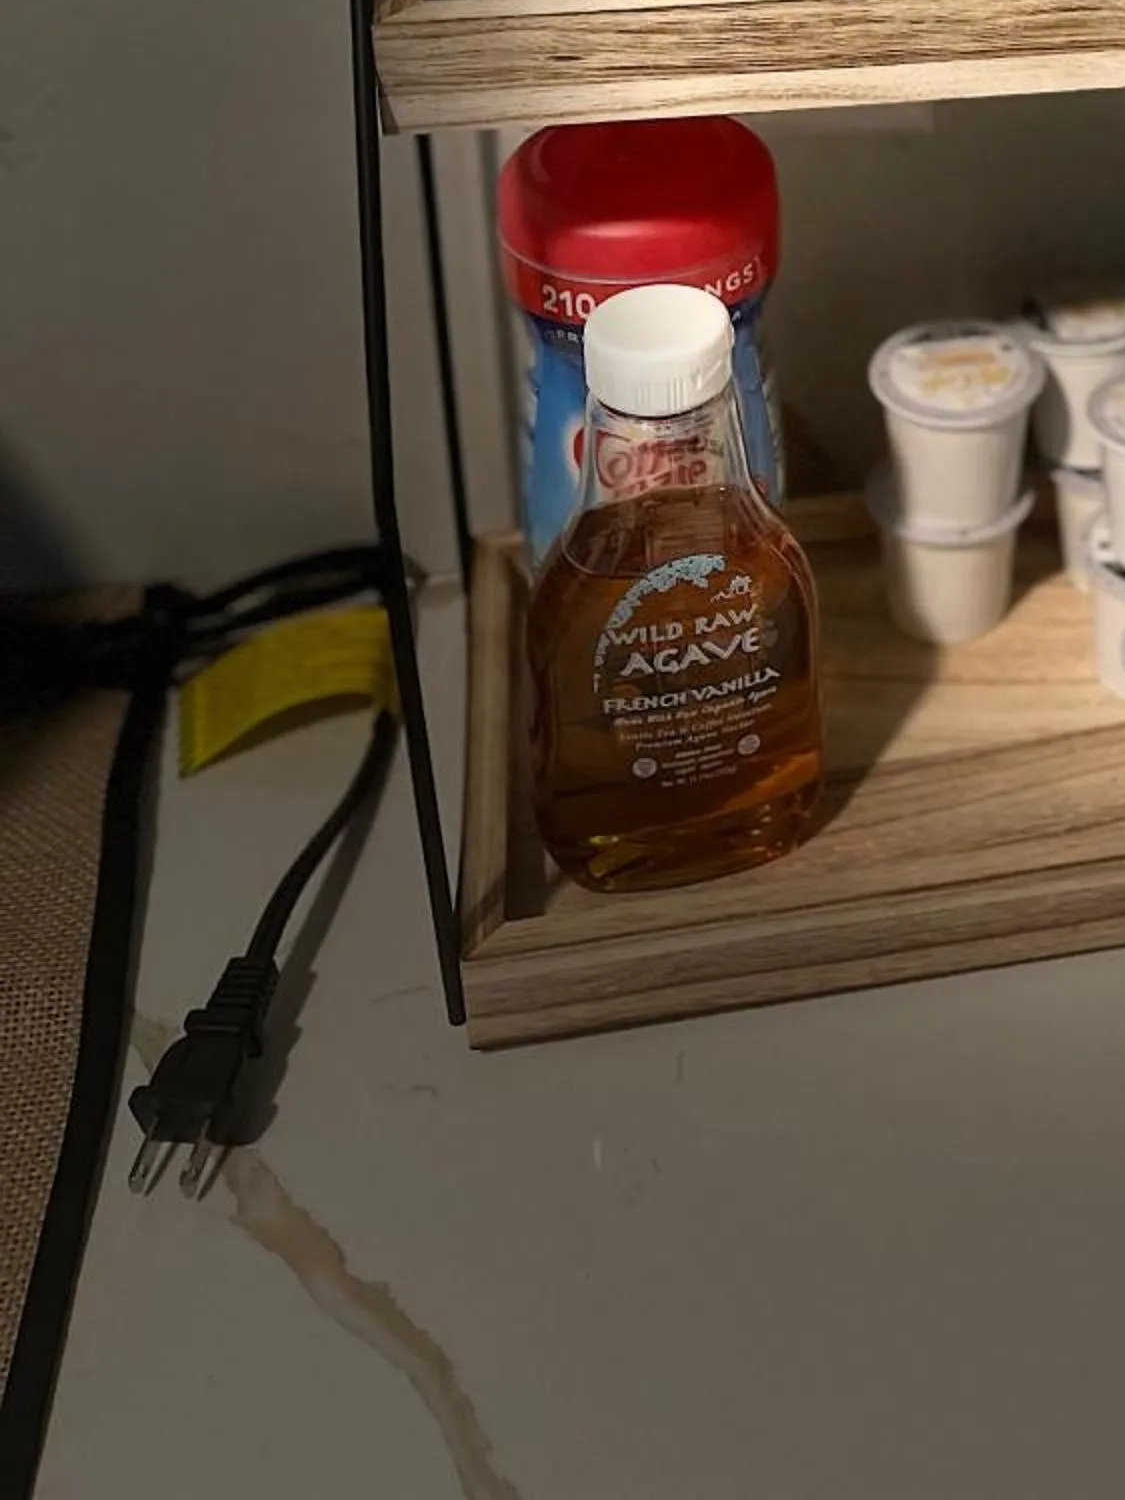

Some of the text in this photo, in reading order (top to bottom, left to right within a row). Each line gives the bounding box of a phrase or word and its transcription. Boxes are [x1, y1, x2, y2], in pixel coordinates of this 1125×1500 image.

[540, 283, 597, 320] 210
[606, 603, 759, 646] WILD RAW
[619, 626, 762, 678] AGAVE
[602, 691, 688, 715] FRENCH
[690, 666, 783, 702] VANILLA
